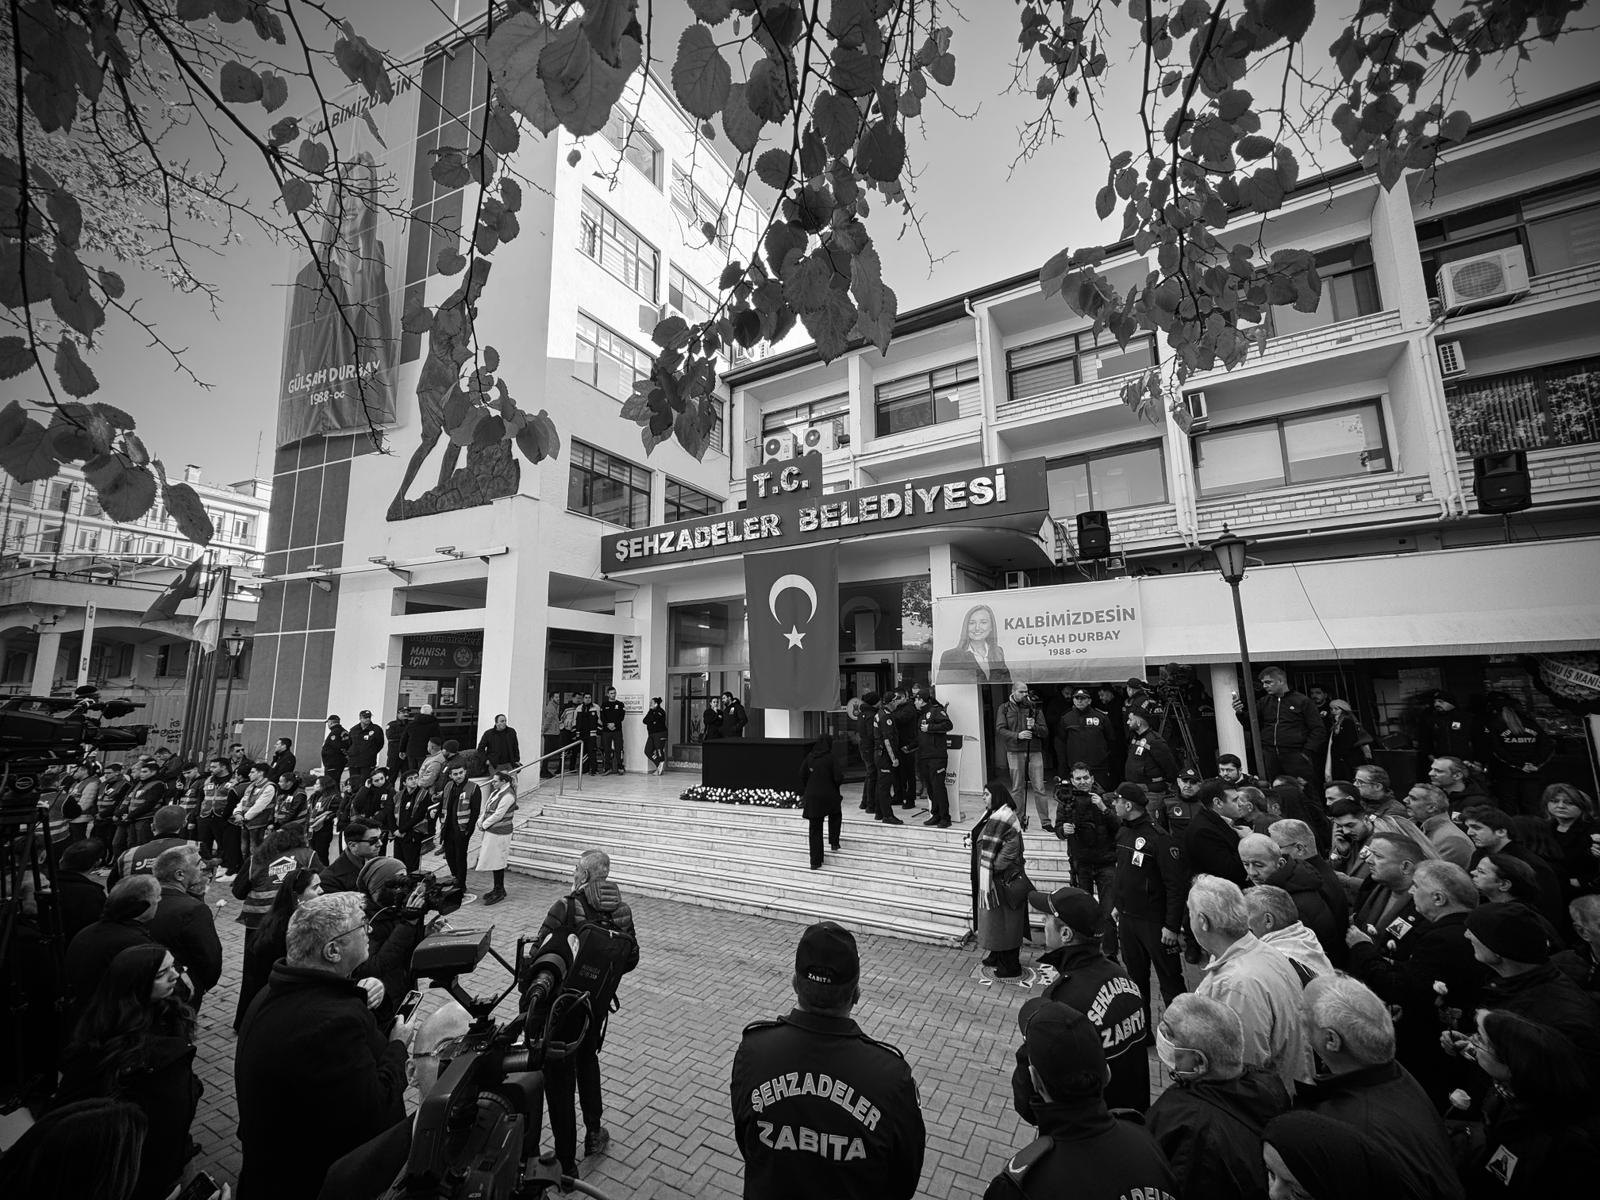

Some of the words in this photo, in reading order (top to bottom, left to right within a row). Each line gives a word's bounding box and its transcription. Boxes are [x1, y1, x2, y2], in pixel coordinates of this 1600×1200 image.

[288, 369, 327, 394] GÜLŞAH
[753, 466, 810, 498] T.C.
[615, 513, 783, 562] ŞEHZADELER
[799, 468, 1007, 532] BELEDİYESİ
[1004, 604, 1136, 630] KALBİMİZDESİN
[1017, 633, 1065, 647] GÜLŞAH
[1068, 630, 1121, 643] DURBAY
[807, 972, 832, 984] ZABITA
[751, 1071, 882, 1132] ŞEHZADELER
[757, 1120, 867, 1161] ZABITA
